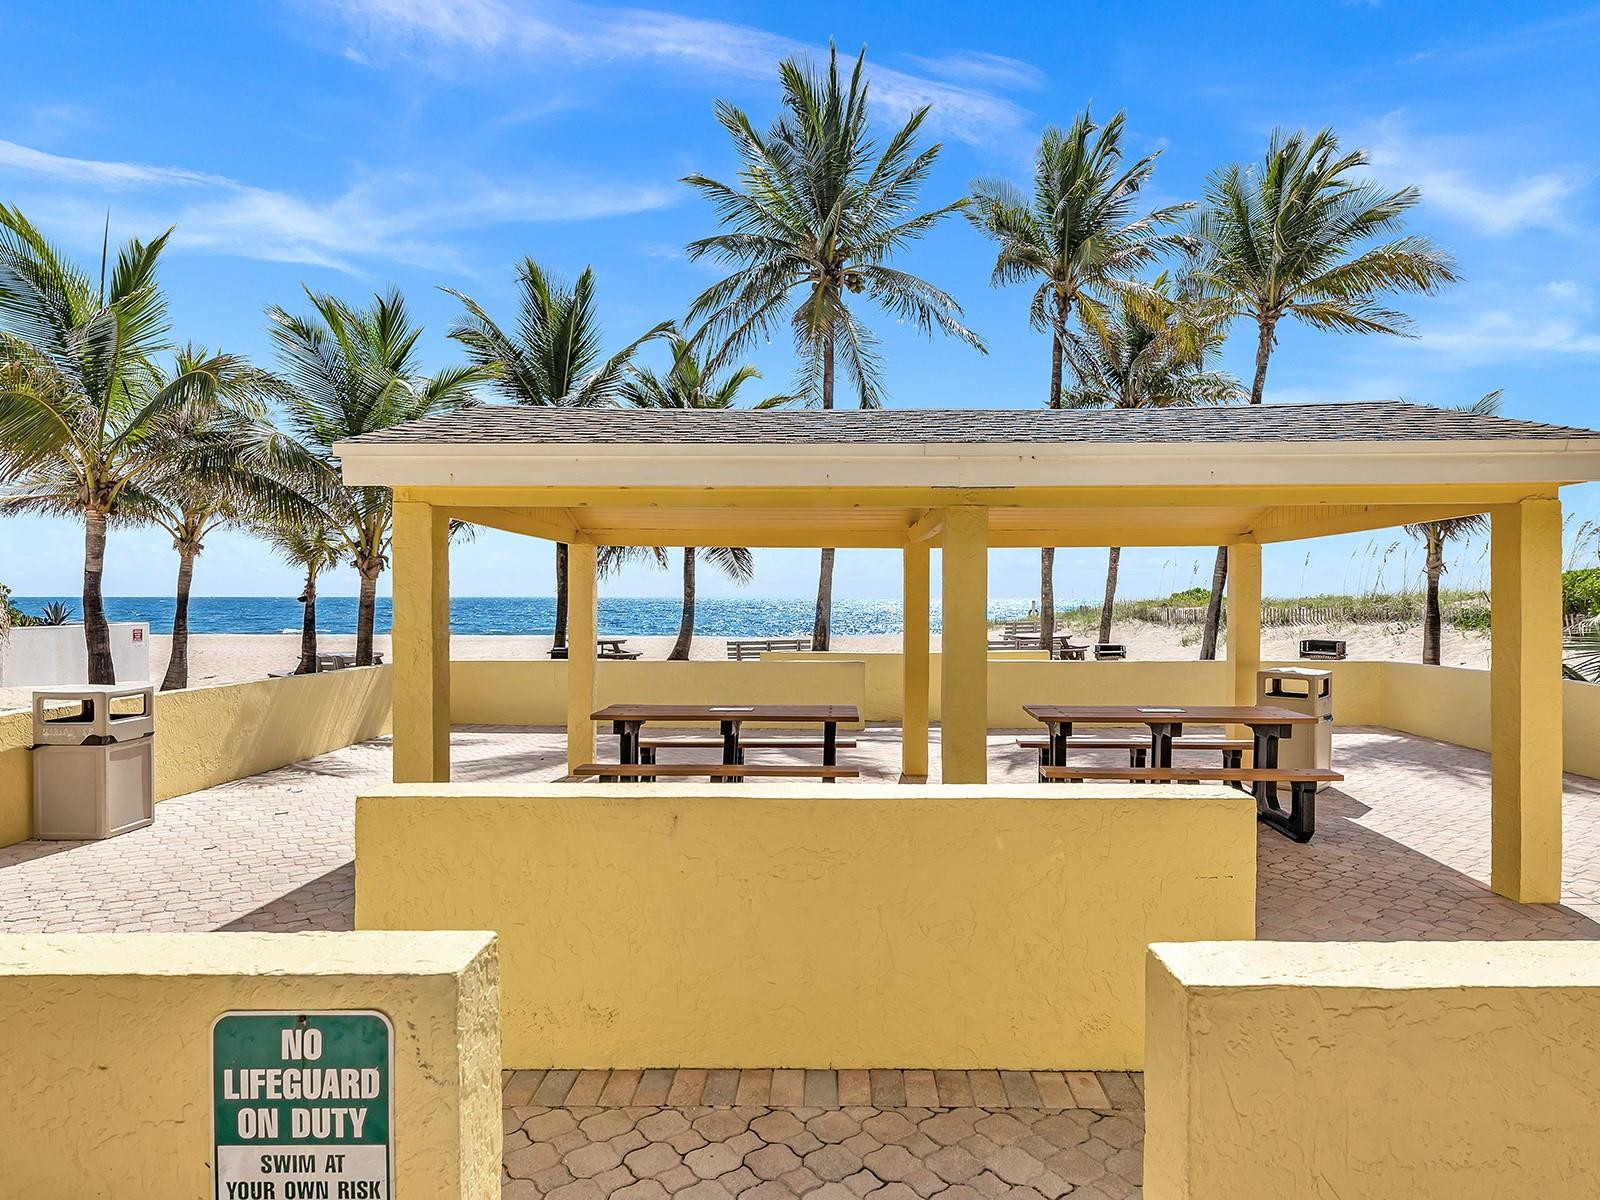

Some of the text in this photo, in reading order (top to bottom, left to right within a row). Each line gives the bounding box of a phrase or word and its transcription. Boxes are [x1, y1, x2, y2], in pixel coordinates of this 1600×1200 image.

[281, 1028, 323, 1061] NO
[223, 1068, 381, 1100] LIFEGUARD
[237, 1107, 368, 1140] ON DUTY
[260, 1154, 346, 1174] SWIM AT
[226, 1181, 382, 1200] YOUR OWN RISK
